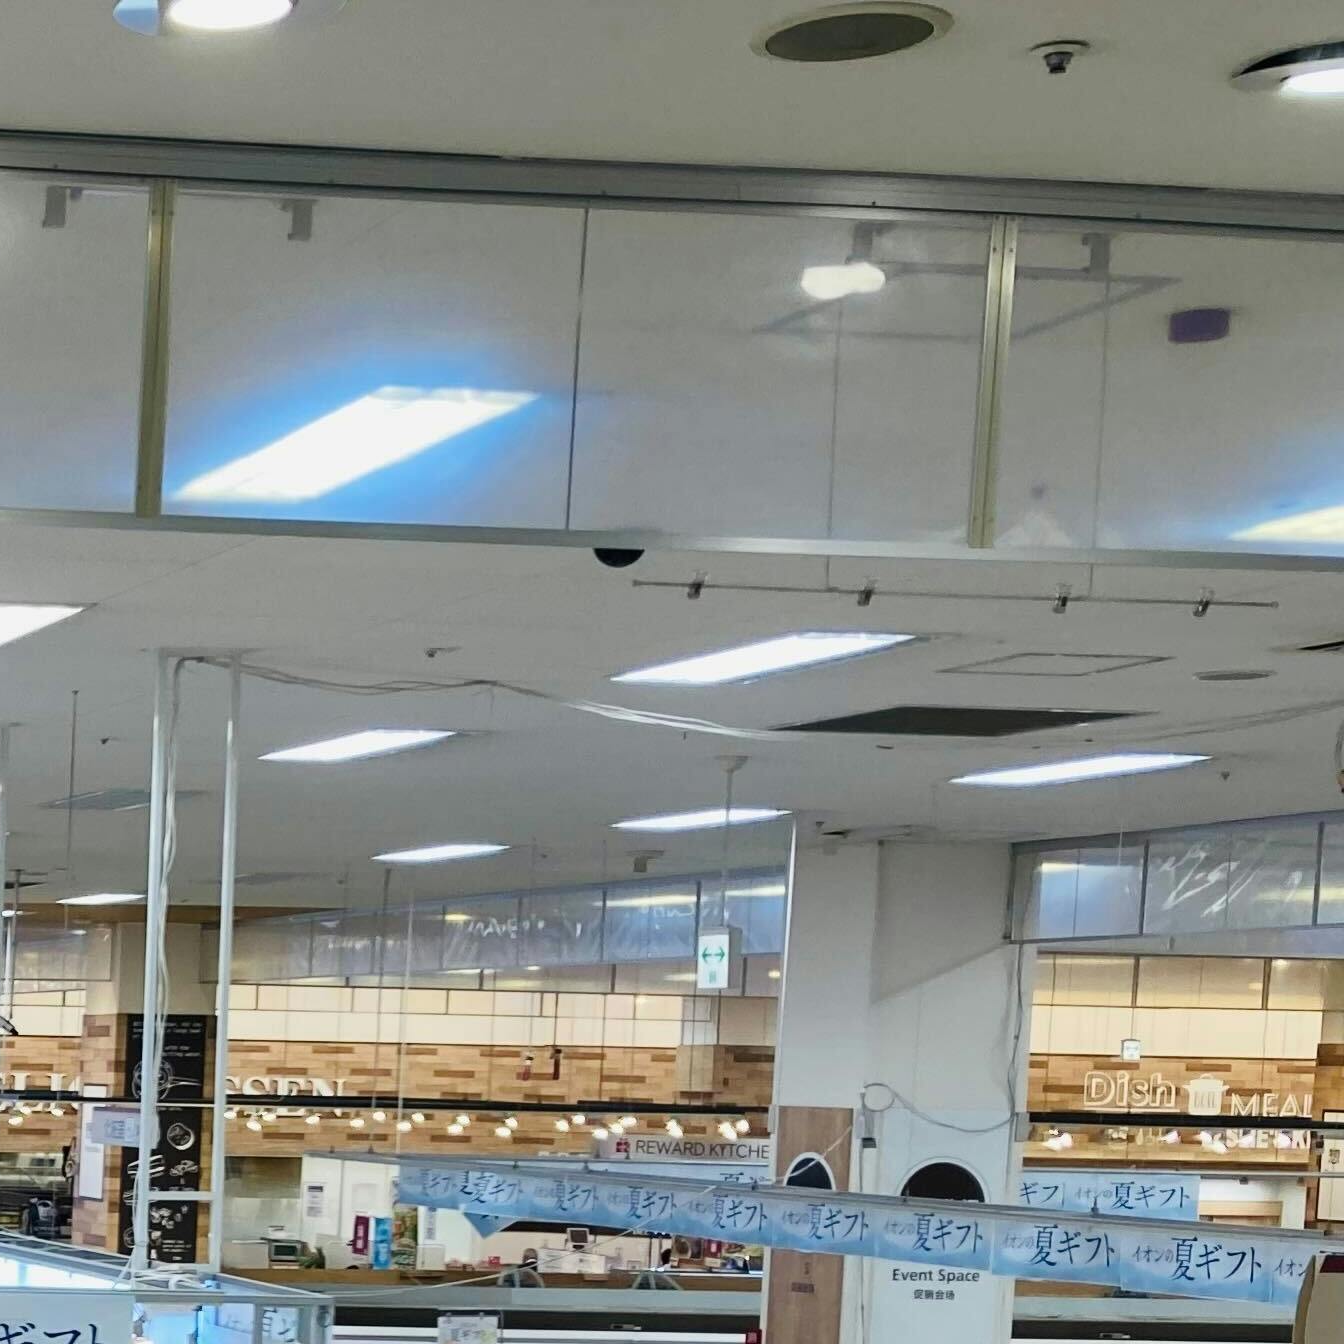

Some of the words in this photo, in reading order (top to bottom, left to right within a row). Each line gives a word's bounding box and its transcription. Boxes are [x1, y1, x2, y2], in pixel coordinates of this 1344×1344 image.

[1084, 1072, 1176, 1107] Dish
[635, 1139, 705, 1157] REWARD
[1132, 1236, 1262, 1284] イオンの夏ギフト
[892, 1268, 934, 1281] Event
[938, 1268, 981, 1284] Space
